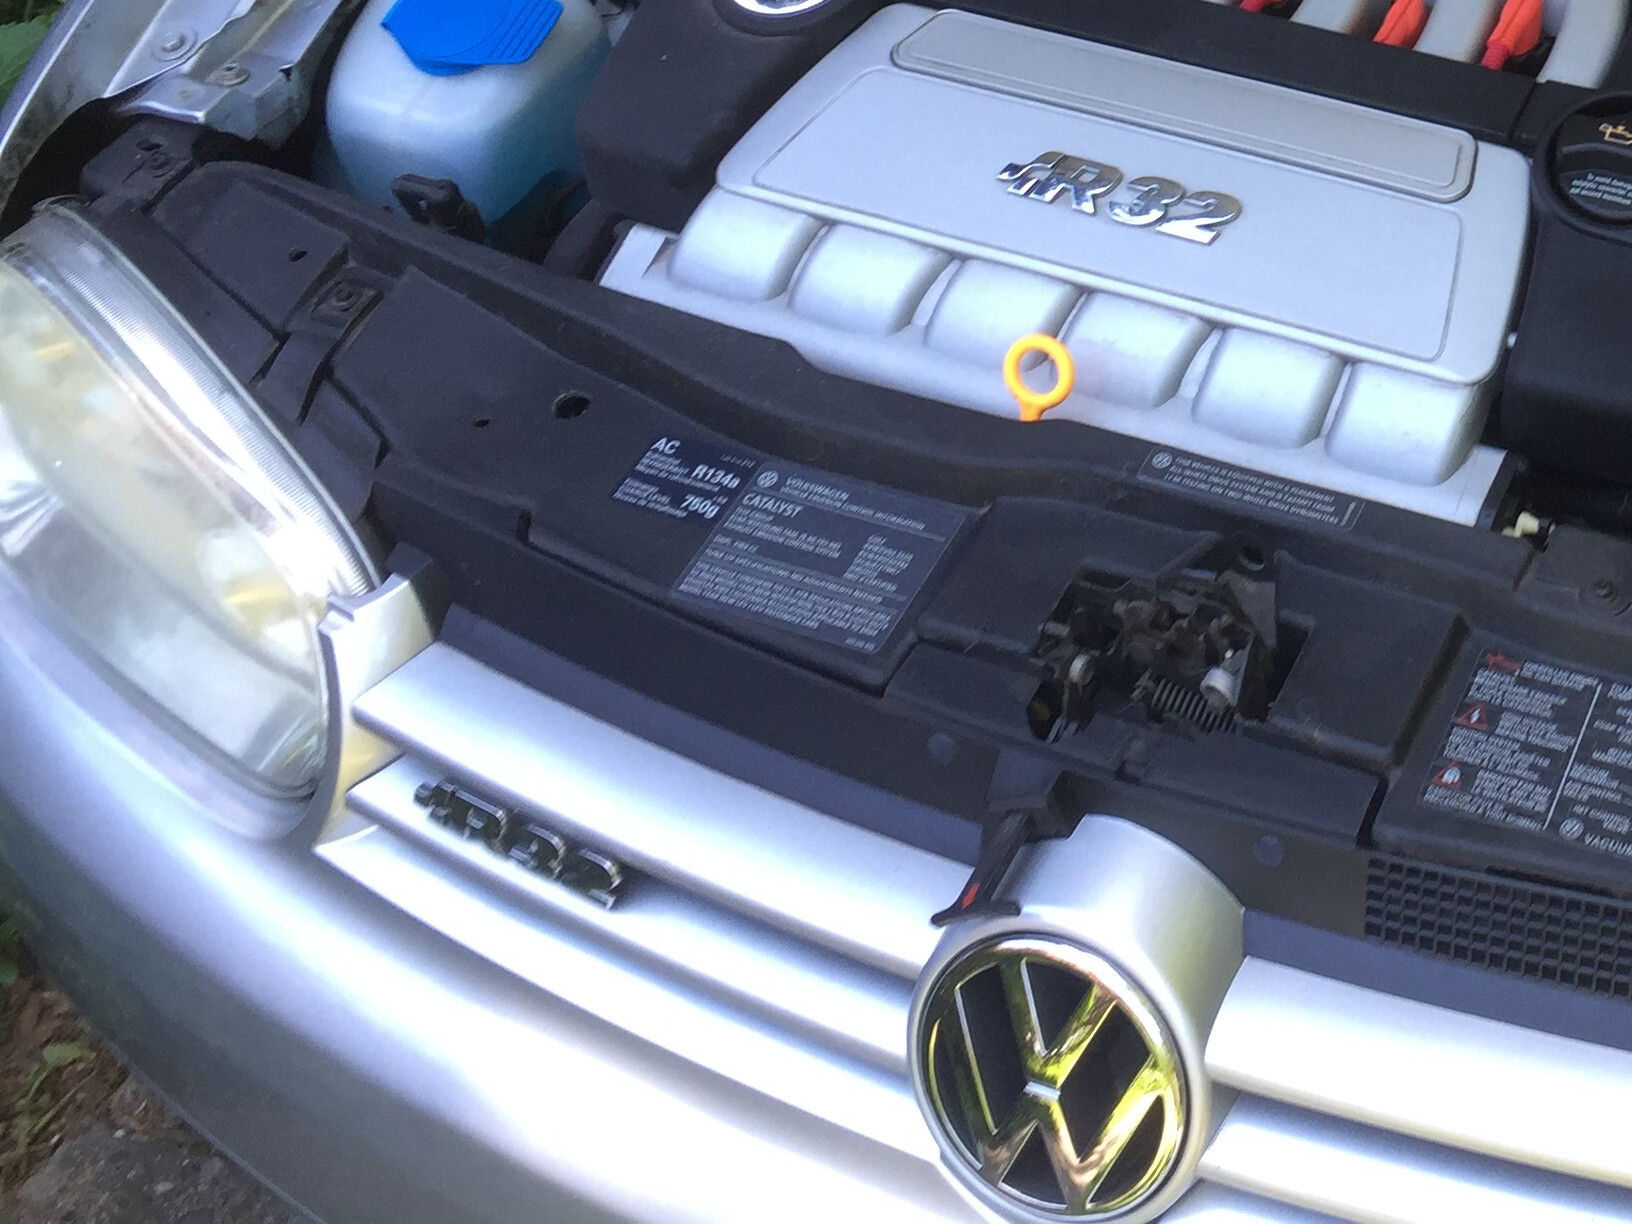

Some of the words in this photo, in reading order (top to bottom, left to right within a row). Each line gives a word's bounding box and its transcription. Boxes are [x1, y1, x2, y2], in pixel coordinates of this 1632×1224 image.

[996, 150, 1243, 246] R32
[650, 437, 680, 454] AC
[784, 477, 850, 500] VOLKSWAGEN
[741, 493, 803, 517] CATALYST
